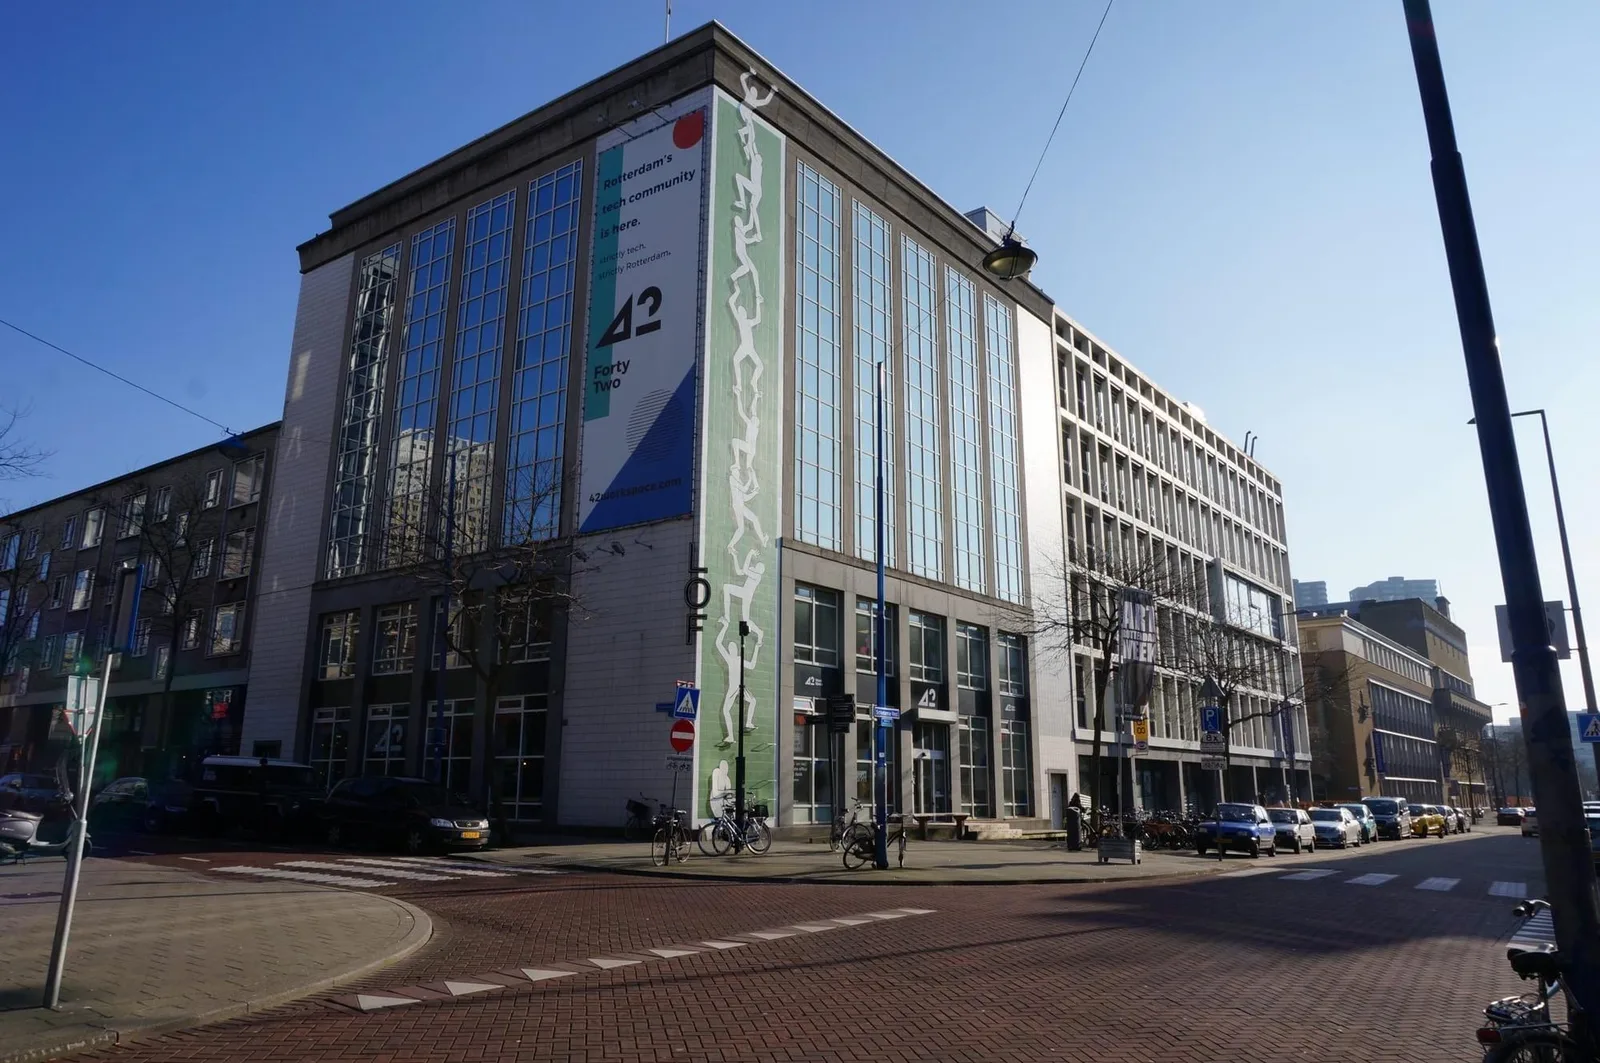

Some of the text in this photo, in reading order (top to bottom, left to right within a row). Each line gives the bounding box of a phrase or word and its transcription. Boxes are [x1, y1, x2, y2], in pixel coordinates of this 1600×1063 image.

[603, 153, 673, 191] Rotterdam's
[602, 169, 696, 215] tech community
[600, 219, 641, 239] is here.
[598, 249, 672, 281] strictly Rotterdam.
[600, 249, 626, 264] strictly
[595, 285, 663, 349] 42
[594, 359, 631, 379] Forty
[593, 377, 621, 395] Two
[917, 687, 936, 708] 42
[1206, 709, 1215, 722] P
[372, 724, 404, 753] 42
